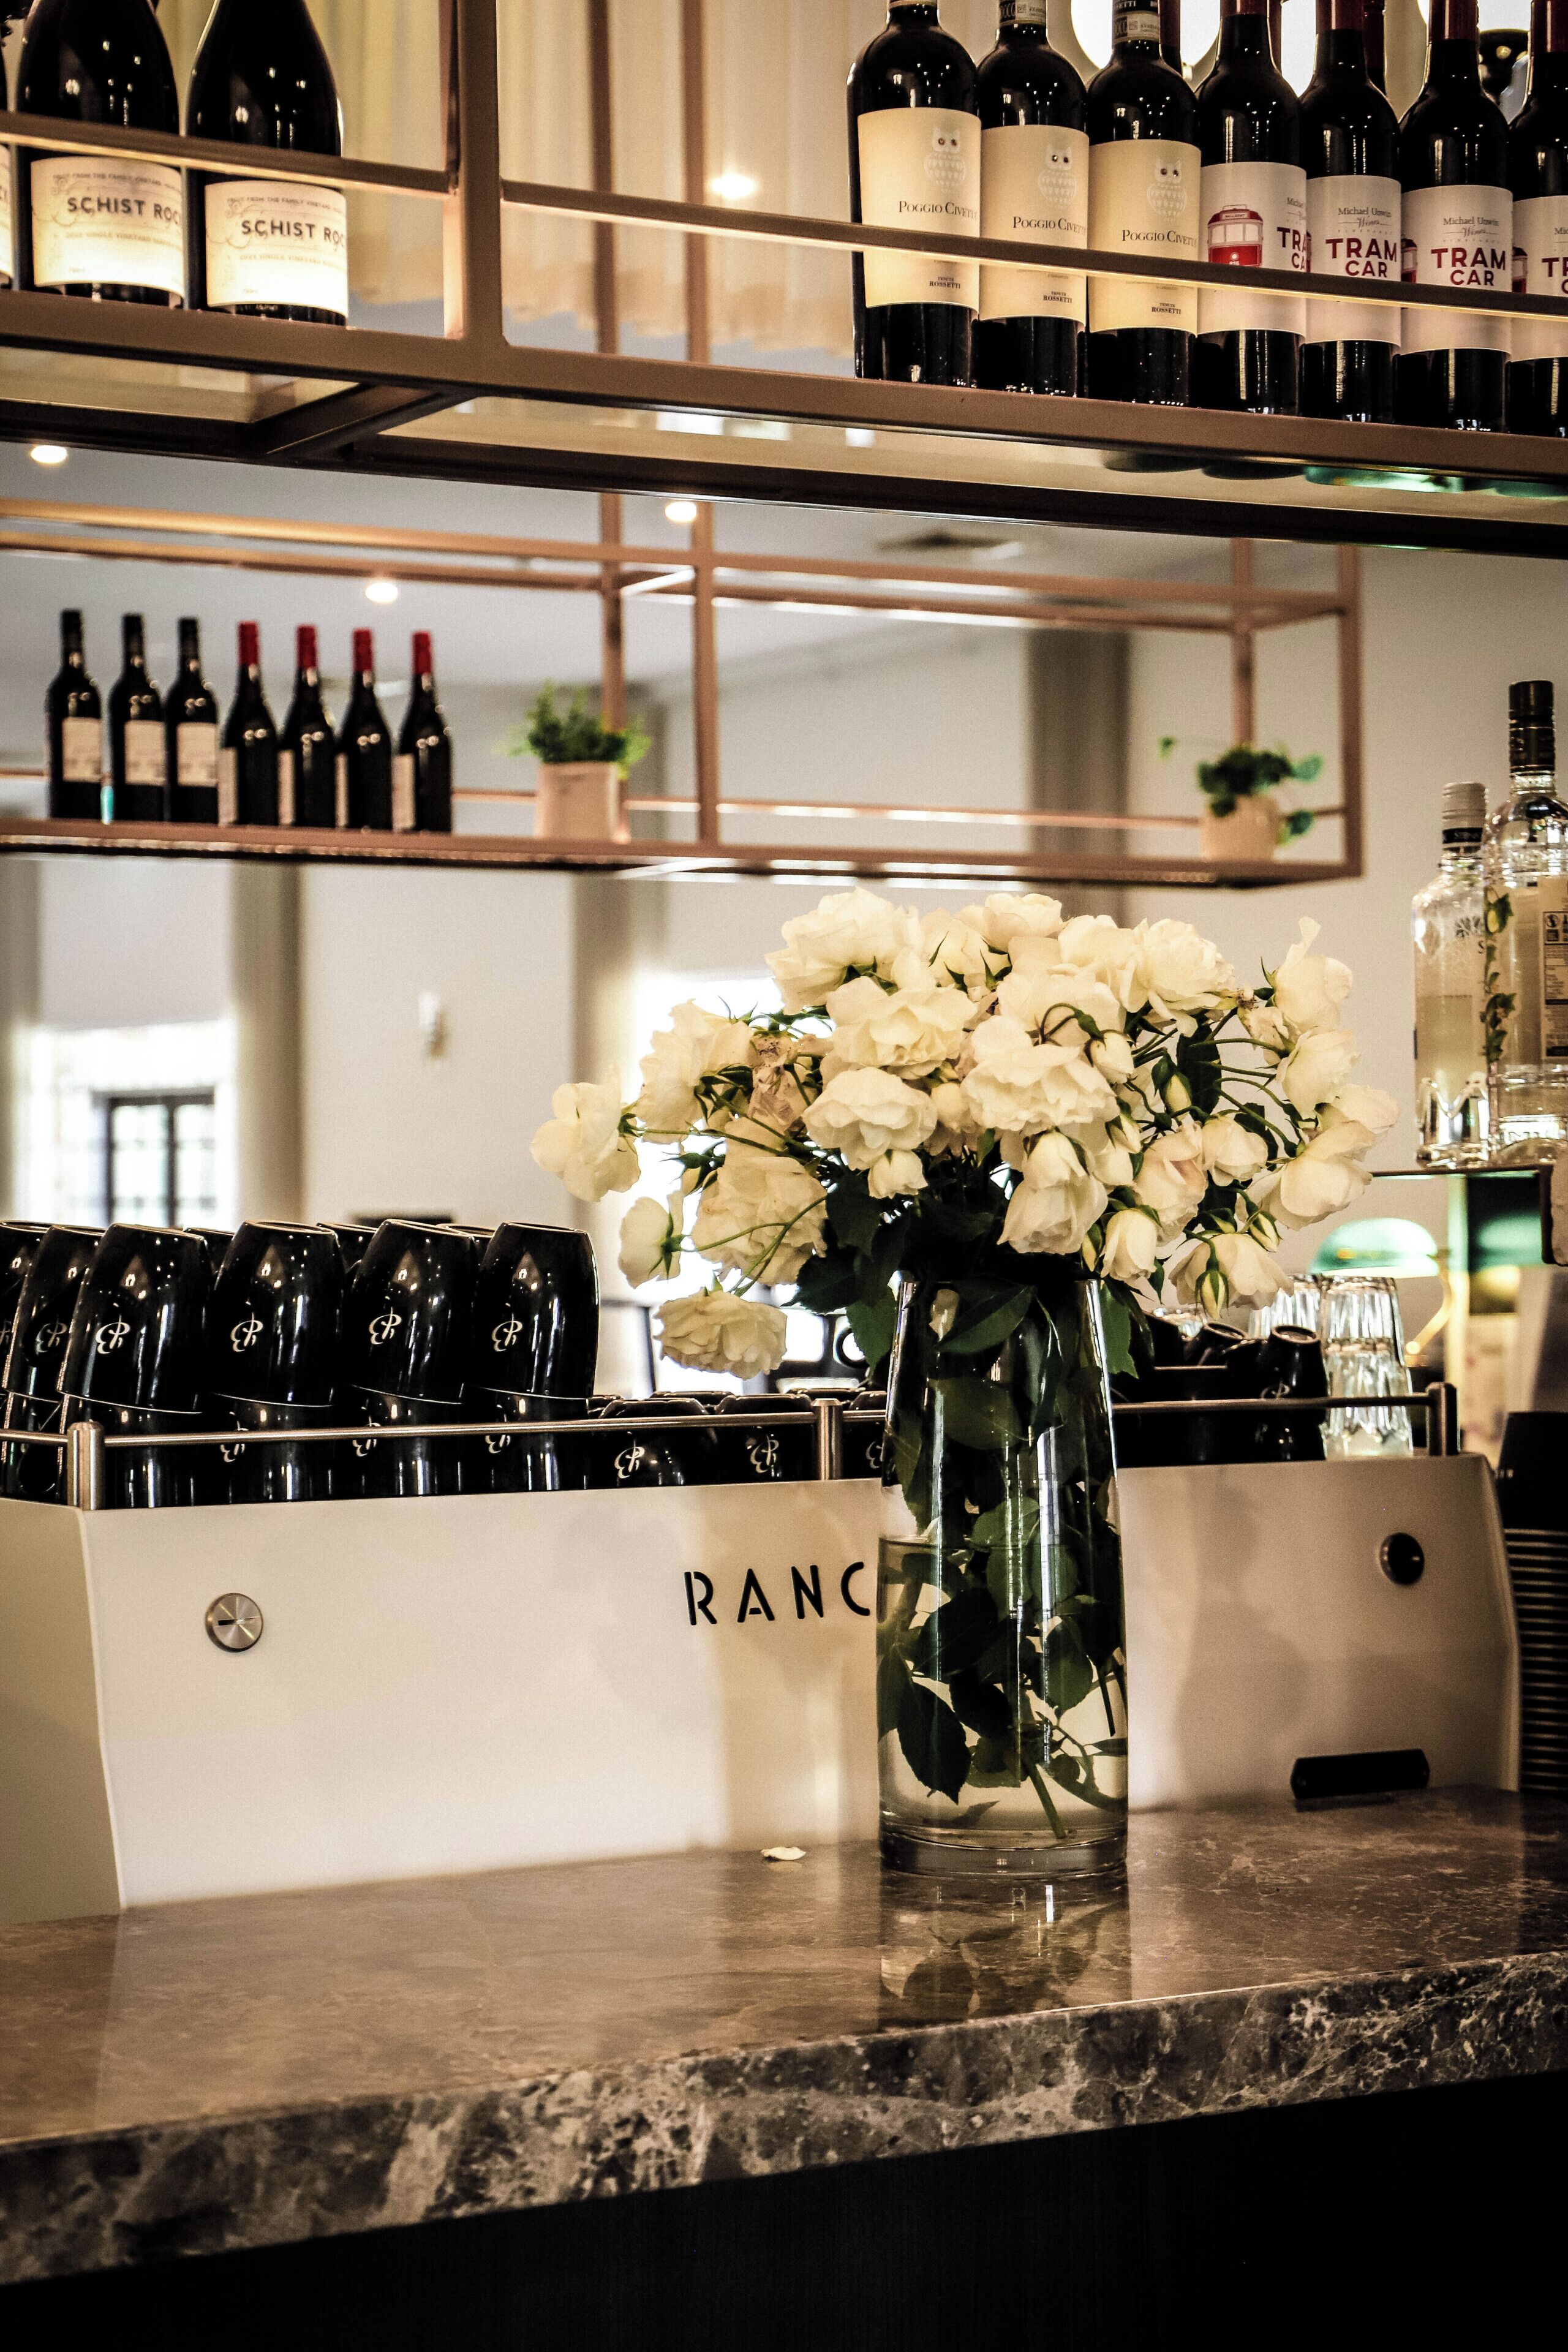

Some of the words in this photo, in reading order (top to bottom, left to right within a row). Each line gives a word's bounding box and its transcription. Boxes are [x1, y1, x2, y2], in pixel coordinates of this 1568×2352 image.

[67, 196, 145, 215] SCHIST
[898, 200, 942, 213] POGGIO
[1338, 206, 1369, 215] Michael
[1013, 216, 1056, 228] POGGIO
[1443, 216, 1474, 225] Michael
[241, 218, 315, 238] SCHIST
[1121, 229, 1165, 241] POGGIO
[1325, 238, 1397, 262] TRAM
[1431, 247, 1506, 270] TRAM
[1345, 260, 1387, 277] CAR
[1450, 270, 1494, 286] CAR
[1152, 306, 1182, 315] ROSSETTI
